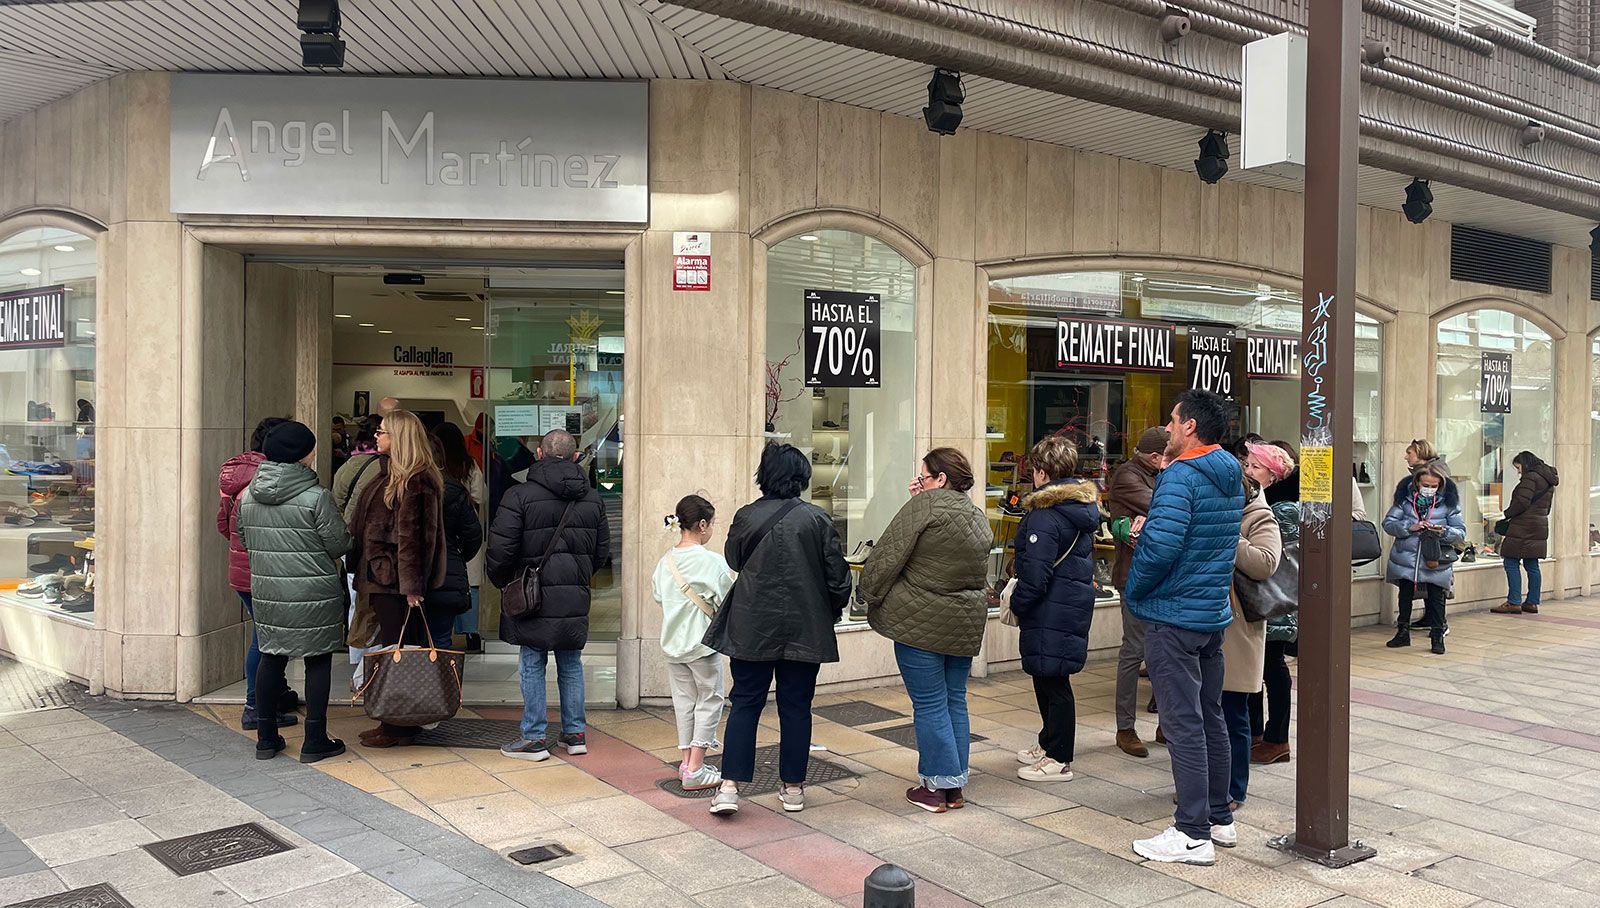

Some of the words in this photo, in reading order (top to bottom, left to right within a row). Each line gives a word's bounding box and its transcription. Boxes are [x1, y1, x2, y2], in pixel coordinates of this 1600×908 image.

[197, 107, 354, 183] Angel
[380, 109, 621, 188] Martínez
[676, 257, 708, 265] Alarma
[0, 298, 30, 343] EMATE
[33, 294, 64, 340] FINAL
[811, 302, 855, 323] HASTA
[858, 305, 873, 323] EL
[812, 326, 874, 376] 70%
[1058, 321, 1124, 365] REMATE
[1129, 326, 1174, 368] FINAL
[1191, 335, 1220, 352] HASTA
[1221, 338, 1231, 352] EL
[1247, 337, 1298, 374] REMATE
[1191, 354, 1231, 394] 70%
[1484, 360, 1501, 372] HASTA
[1502, 361, 1509, 373] EL
[1484, 374, 1509, 406] 70%
